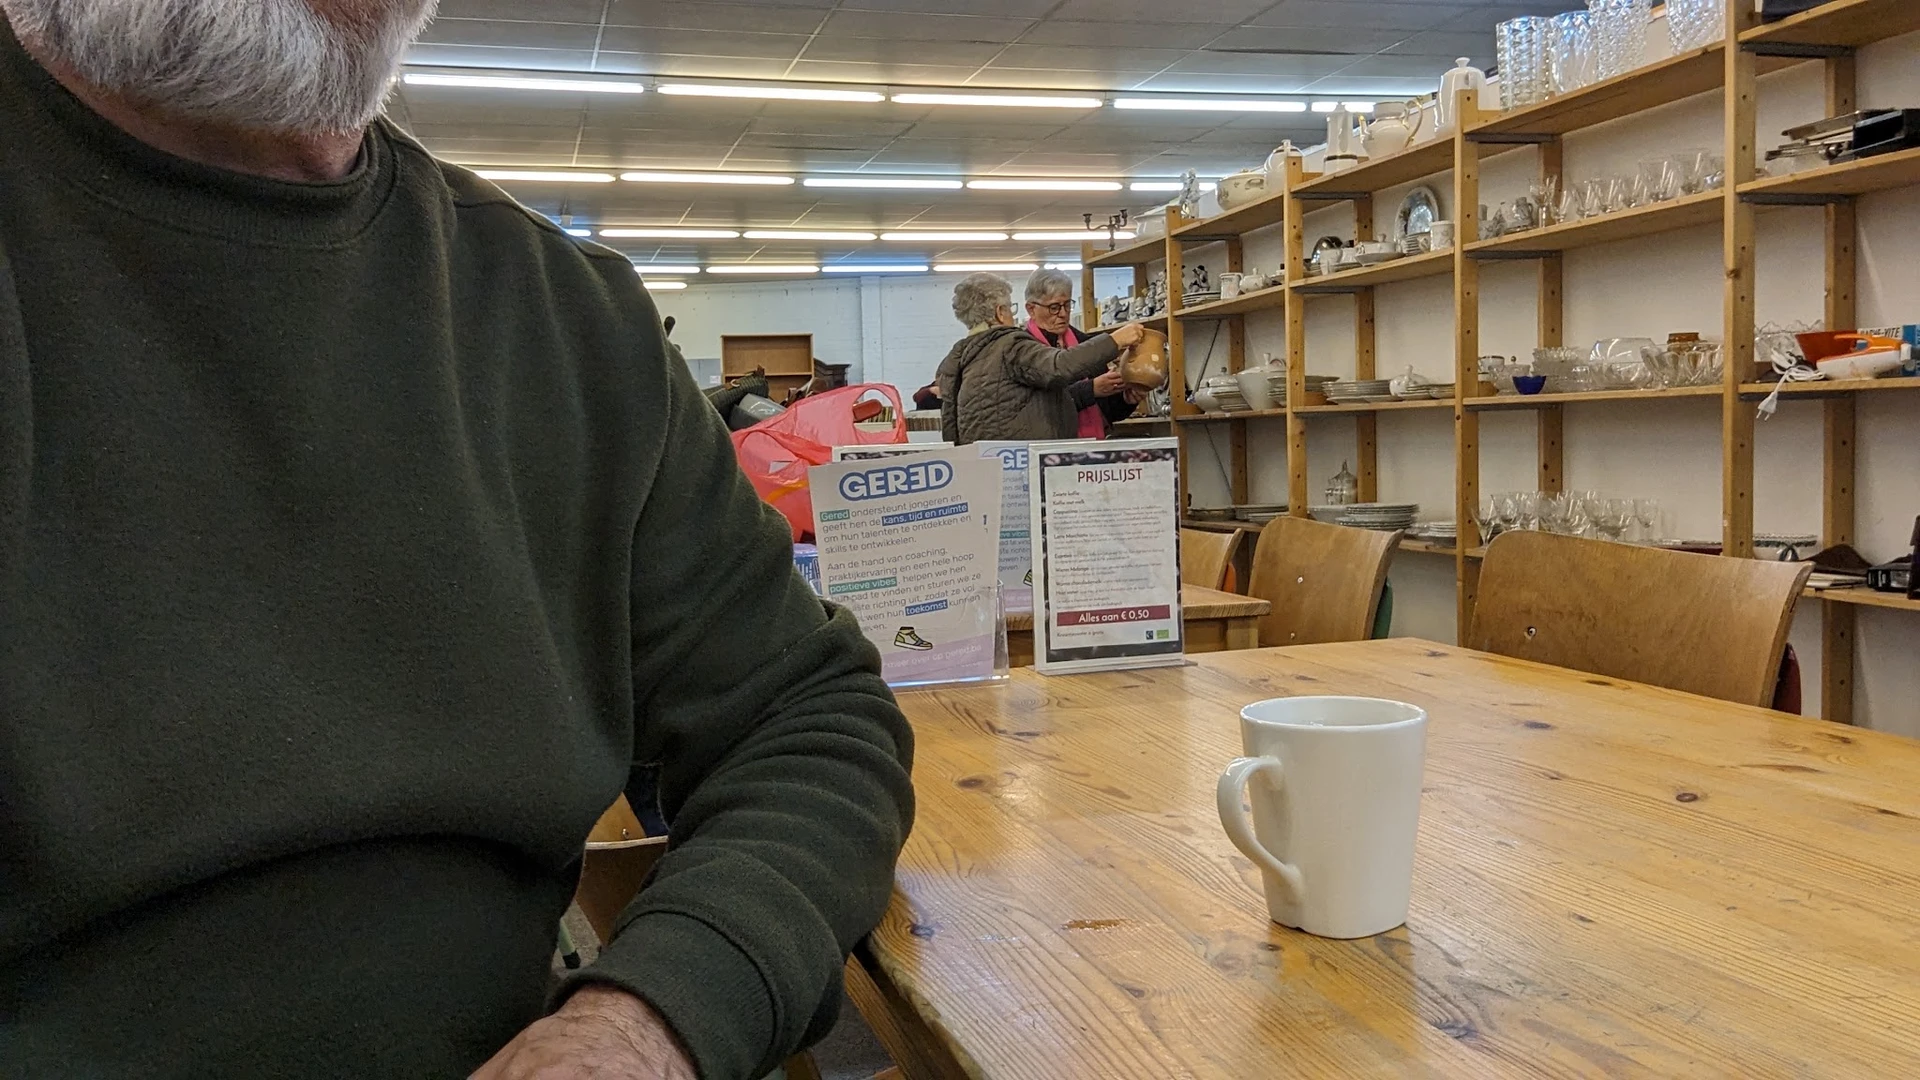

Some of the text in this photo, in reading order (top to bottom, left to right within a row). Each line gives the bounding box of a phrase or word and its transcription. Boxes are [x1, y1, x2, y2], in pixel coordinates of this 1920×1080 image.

[840, 461, 953, 500] GERED
[1078, 468, 1142, 483] PRIJSLIJST
[820, 493, 962, 522] Gered ondersteunt jongeren en
[822, 522, 847, 534] geeft
[849, 519, 868, 529] hen
[869, 517, 881, 527] de
[908, 510, 923, 522] tijd
[924, 509, 936, 519] en
[938, 503, 967, 517] ruimte
[823, 514, 972, 544] om hun talenten te ontdekken en
[825, 535, 917, 555] skills te ontwikkelen.
[827, 562, 845, 571] Aan
[848, 559, 860, 570] de
[861, 556, 884, 568] hand
[885, 555, 903, 565] van
[828, 565, 898, 584] praktijkervaring
[899, 563, 912, 573] en
[913, 561, 931, 571] een
[932, 557, 951, 569] hele
[952, 552, 975, 565] hoop
[830, 580, 872, 594] positieve
[902, 571, 934, 585] helpen
[935, 569, 948, 579] we
[949, 565, 967, 576] hen
[869, 590, 880, 600] te
[881, 586, 912, 599] vinden
[913, 584, 926, 593] en
[926, 579, 956, 591] sturen
[956, 576, 970, 585] we
[970, 573, 982, 582] ze
[872, 597, 907, 611] richting
[924, 589, 949, 602] zodat
[950, 587, 961, 597] ze
[886, 607, 905, 619] hun
[905, 601, 948, 615] toekomst
[948, 594, 981, 607] kunnen
[1079, 609, 1150, 624] Alles aan € 0,50
